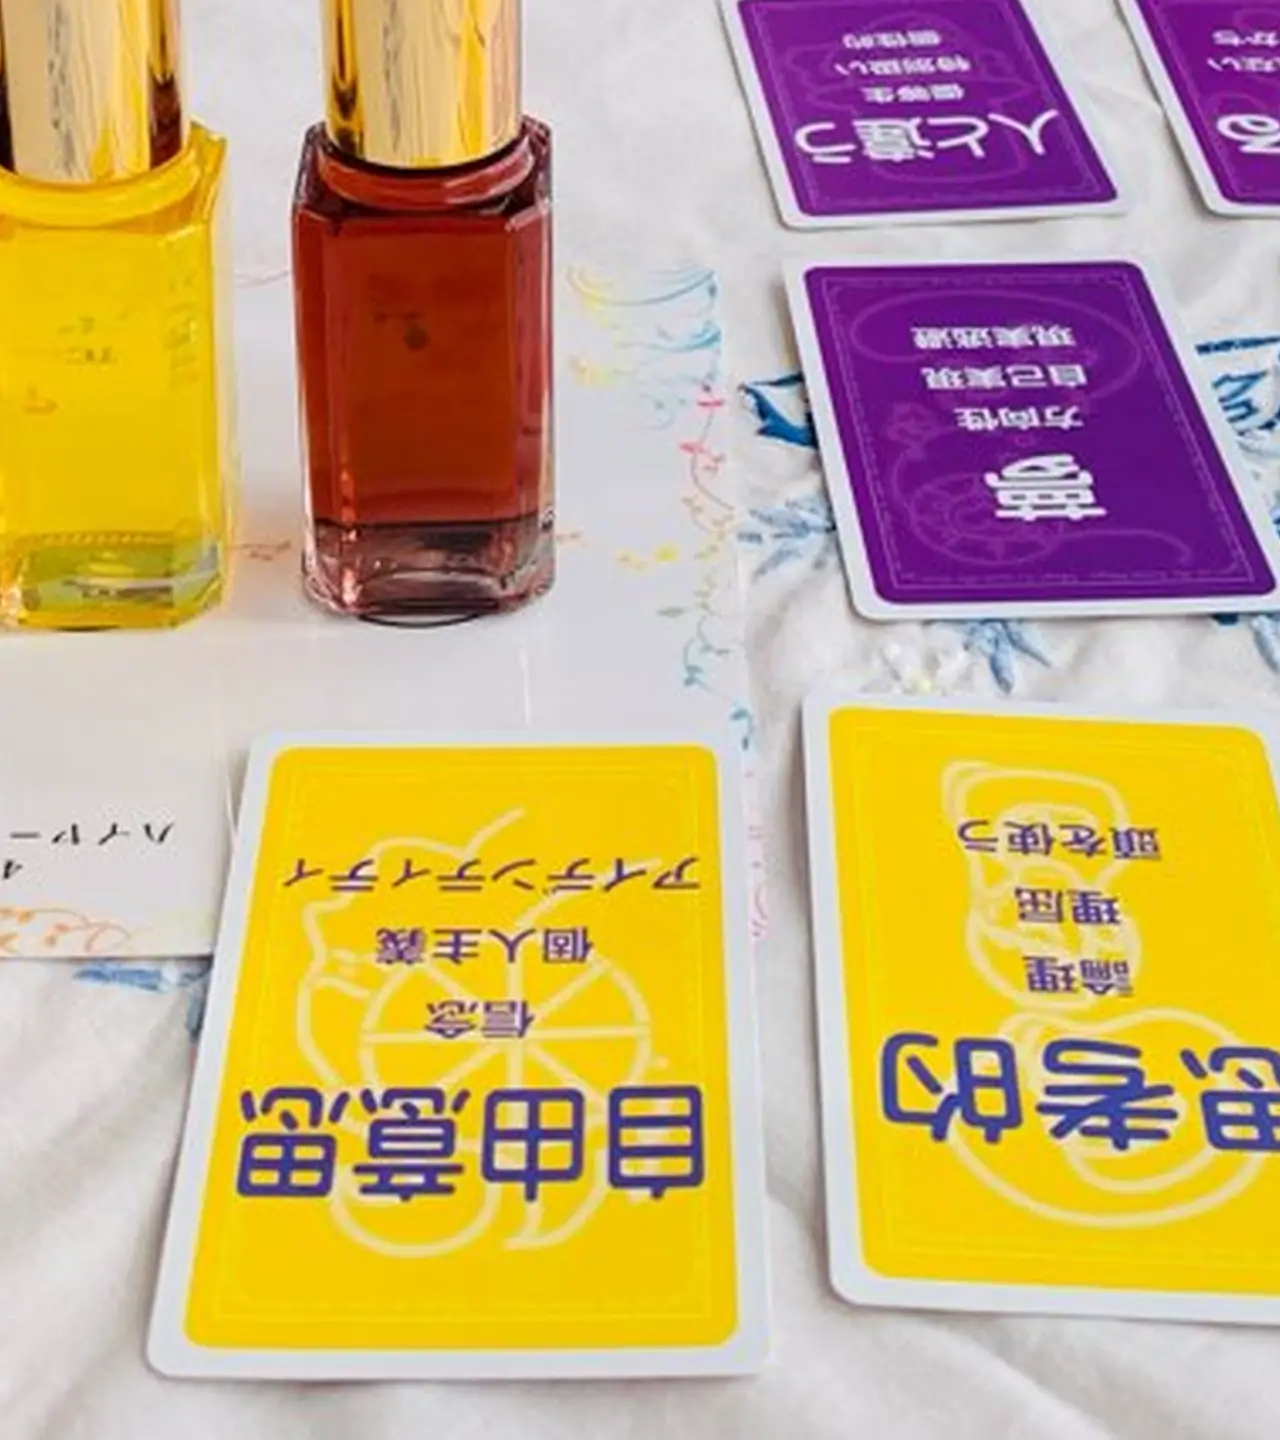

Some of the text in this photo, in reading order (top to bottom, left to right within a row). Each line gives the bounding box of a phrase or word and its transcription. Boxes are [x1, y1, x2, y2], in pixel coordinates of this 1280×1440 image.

[795, 110, 1058, 163] 人と違う
[911, 325, 1077, 349] 現実逃避
[921, 364, 1088, 389] 自己実現
[954, 406, 1083, 430] 方向性
[984, 454, 1107, 521] 夢
[957, 819, 1164, 860] 頭を使う
[283, 857, 701, 895] アイデンティティ
[1014, 886, 1121, 925] 理屈
[376, 926, 594, 965] 個人主義
[1022, 956, 1134, 996] 論理
[425, 1000, 535, 1040] 信念
[236, 1086, 704, 1202] 自由意思
